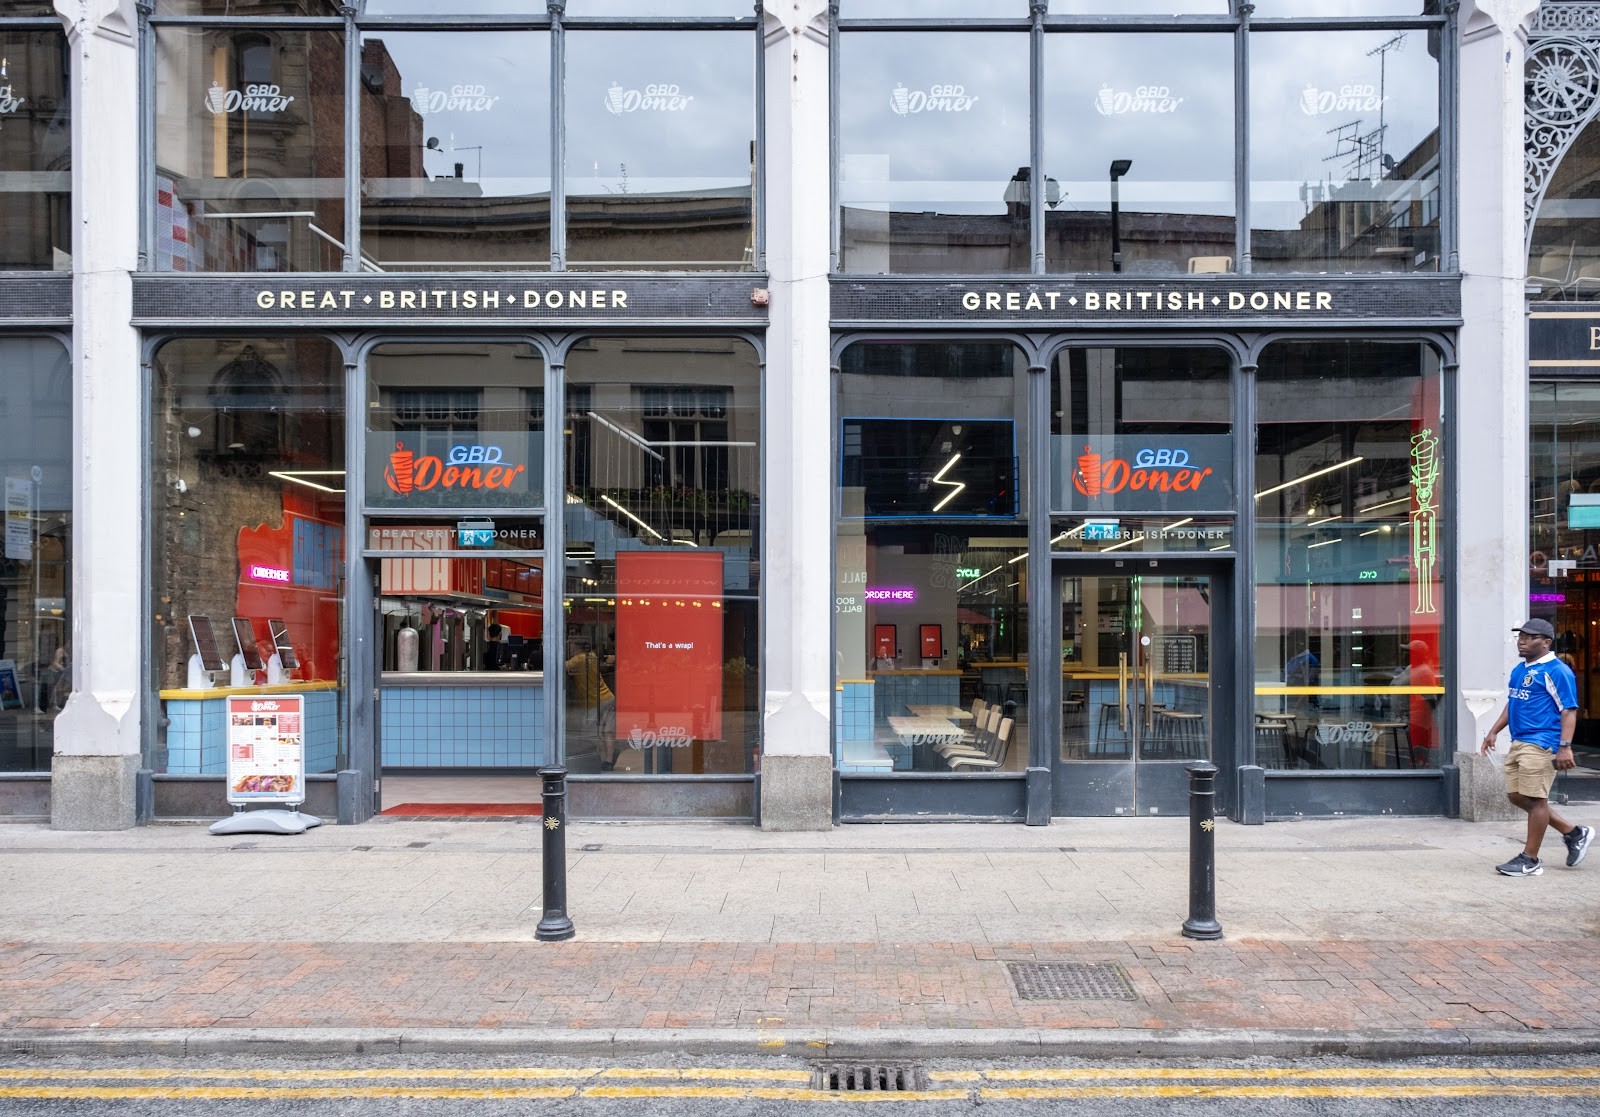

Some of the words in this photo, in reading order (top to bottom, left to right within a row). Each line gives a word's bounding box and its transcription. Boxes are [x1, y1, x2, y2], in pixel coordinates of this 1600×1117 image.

[246, 84, 280, 97] GBD
[451, 85, 485, 97] GBD
[645, 84, 680, 96] GBD
[930, 85, 964, 97] GBD
[1135, 86, 1169, 98] GBD
[1340, 84, 1373, 97] GBD
[223, 90, 295, 113] Doner
[427, 91, 500, 113] Doner
[622, 90, 694, 113] Doner
[908, 90, 979, 113] Doner
[1113, 91, 1184, 114] Doner
[1317, 91, 1389, 113] Doner
[257, 291, 356, 309] GREAT
[380, 290, 499, 309] BRITISH
[524, 290, 628, 308] DONER
[962, 292, 1060, 310] GREAT
[1085, 292, 1204, 310] BRITISH
[1228, 292, 1332, 310] DONER
[449, 445, 503, 463] GBD
[1135, 448, 1189, 466] GBD
[413, 455, 525, 491] Doner
[1101, 458, 1213, 494] Doner
[372, 529, 417, 538] GREAT
[490, 529, 537, 538] DONER
[1115, 531, 1168, 539] BRITISH
[1177, 531, 1224, 539] DONER
[865, 590, 891, 599] ORDER
[892, 590, 914, 599] HERE
[645, 641, 667, 649] That's
[675, 641, 694, 650] wrap!
[659, 726, 686, 736] GBD
[1328, 725, 1384, 743] Doner
[1346, 721, 1373, 731] GBD
[641, 730, 697, 749] Doner
